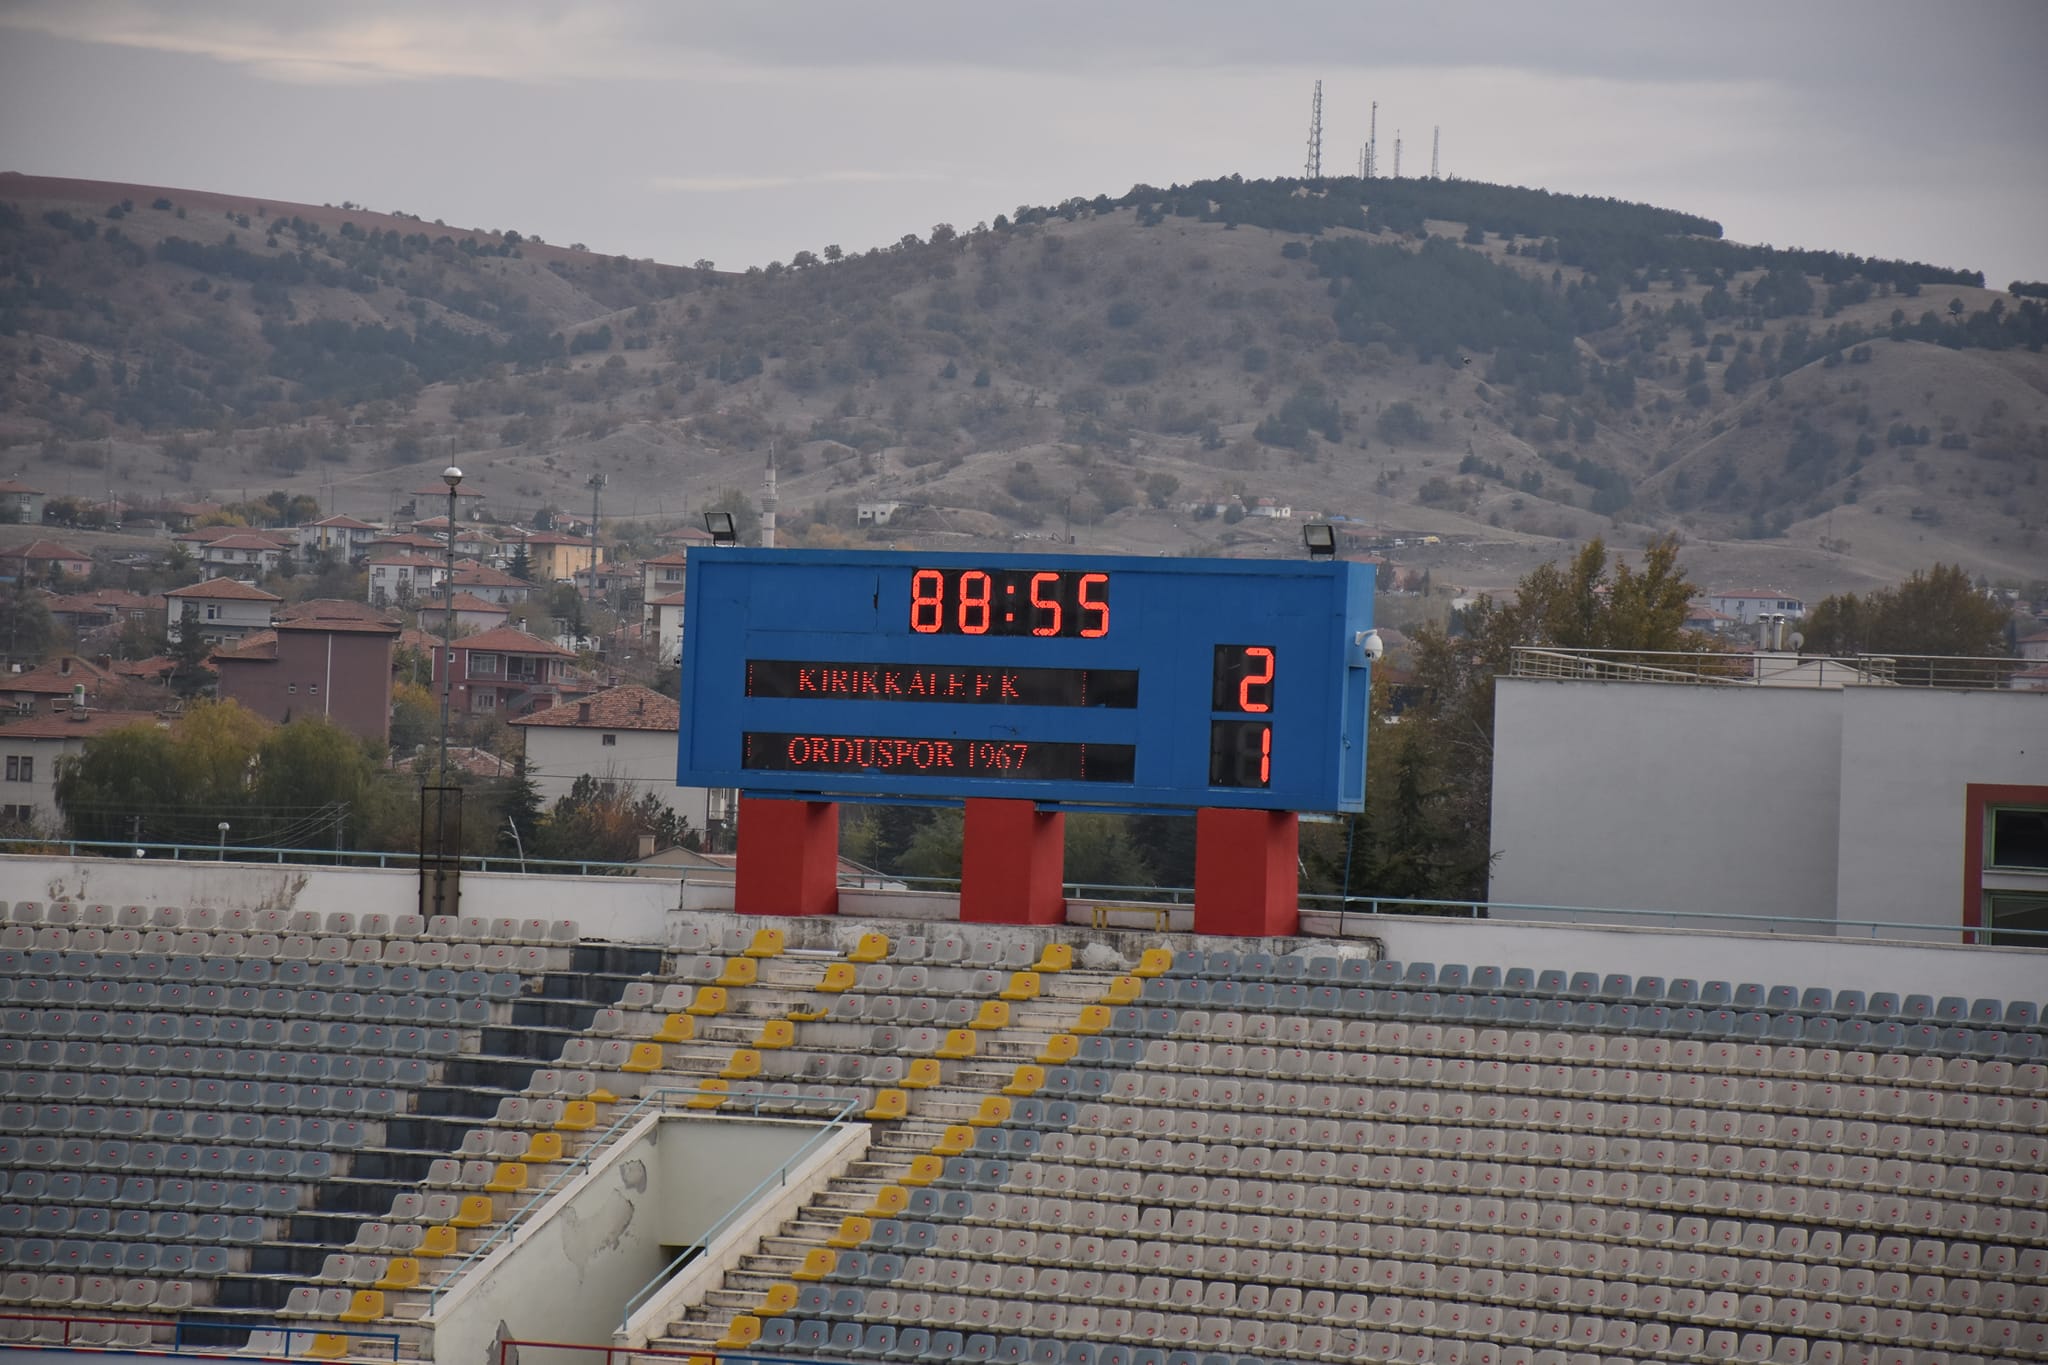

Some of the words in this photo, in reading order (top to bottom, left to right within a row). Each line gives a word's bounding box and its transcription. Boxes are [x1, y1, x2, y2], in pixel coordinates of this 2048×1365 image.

[910, 568, 1110, 638] 88:55
[1238, 646, 1275, 713] 2
[787, 736, 955, 769] ORDUSPOR
[968, 742, 1029, 770] 1967
[1259, 726, 1272, 783] 1
